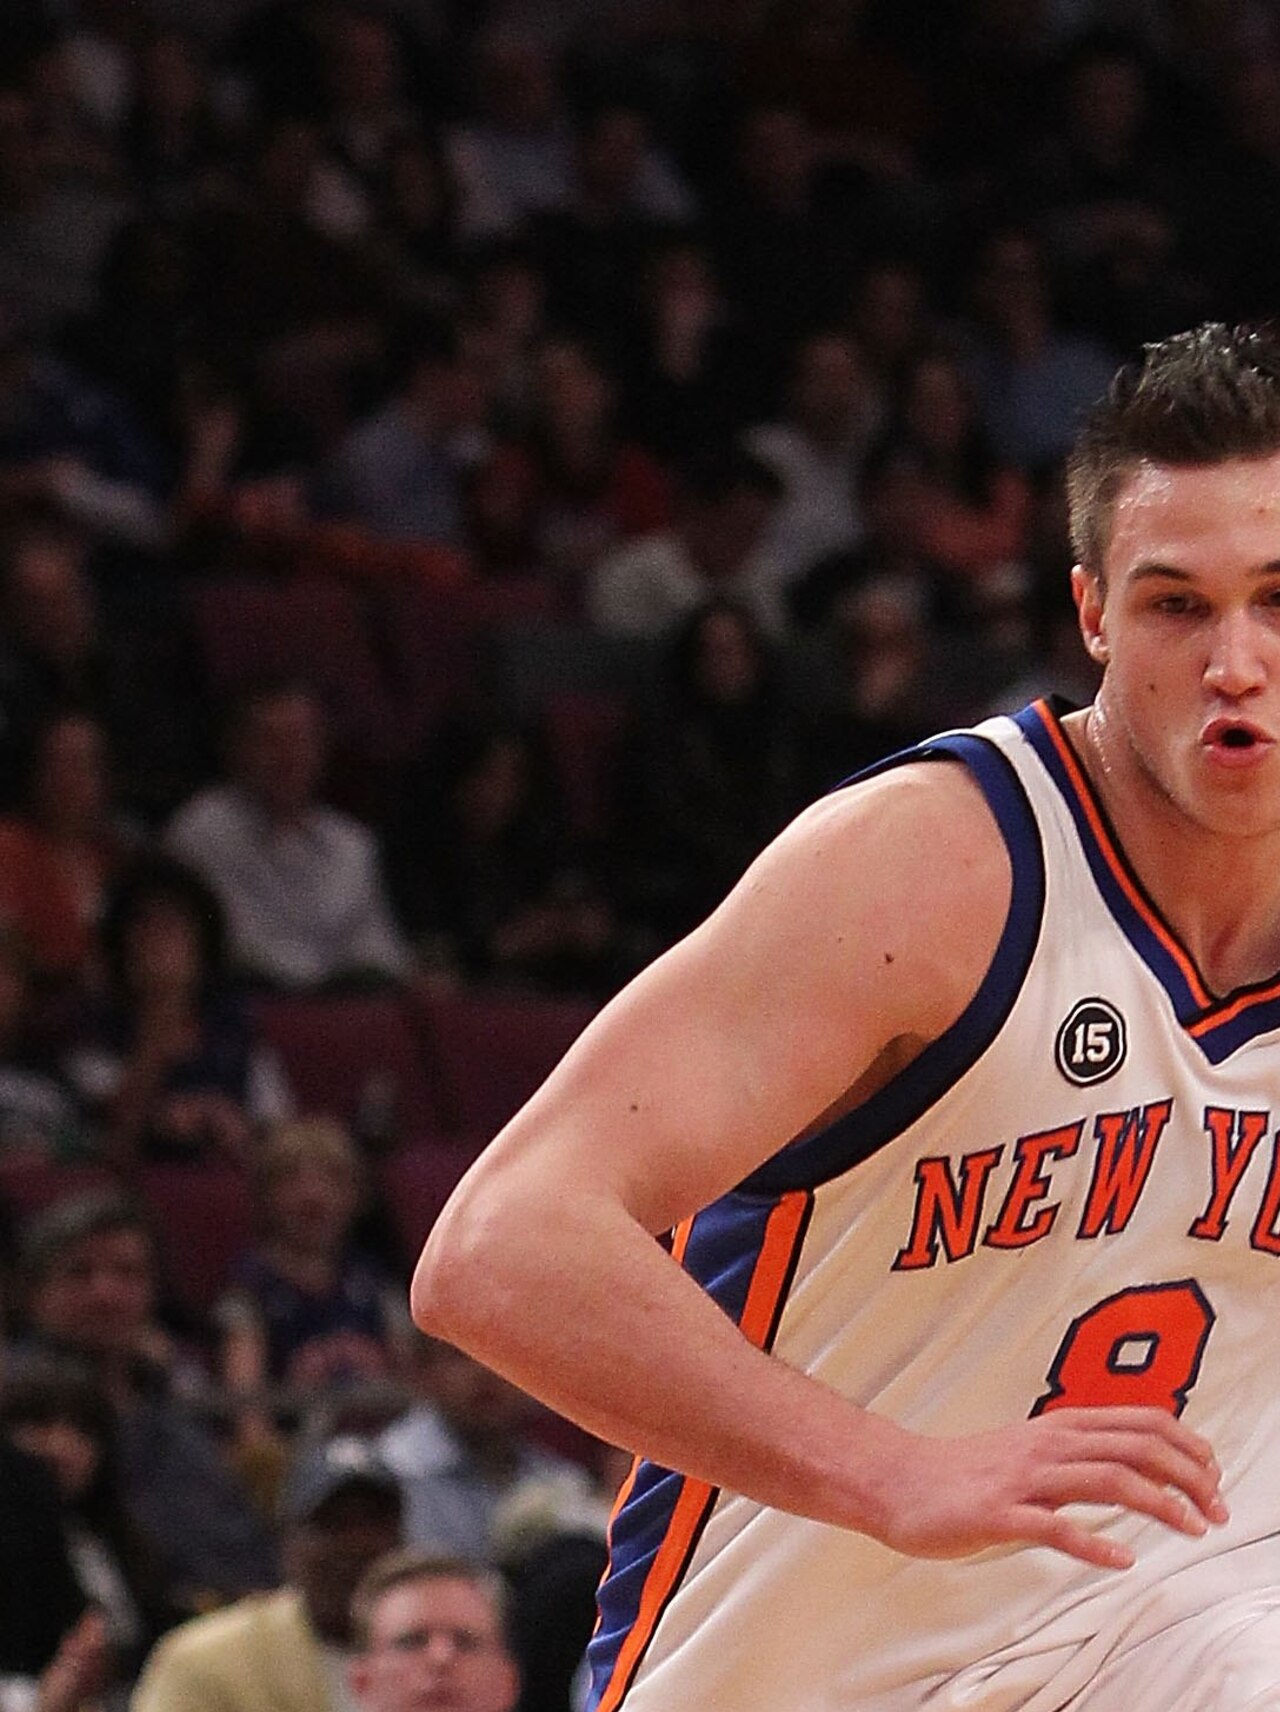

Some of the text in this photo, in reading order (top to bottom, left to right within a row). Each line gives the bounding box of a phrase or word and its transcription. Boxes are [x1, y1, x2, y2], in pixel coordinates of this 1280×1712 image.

[1071, 1022, 1113, 1063] 15
[890, 1097, 1173, 1272] NEW
[1027, 1278, 1216, 1420] 8
